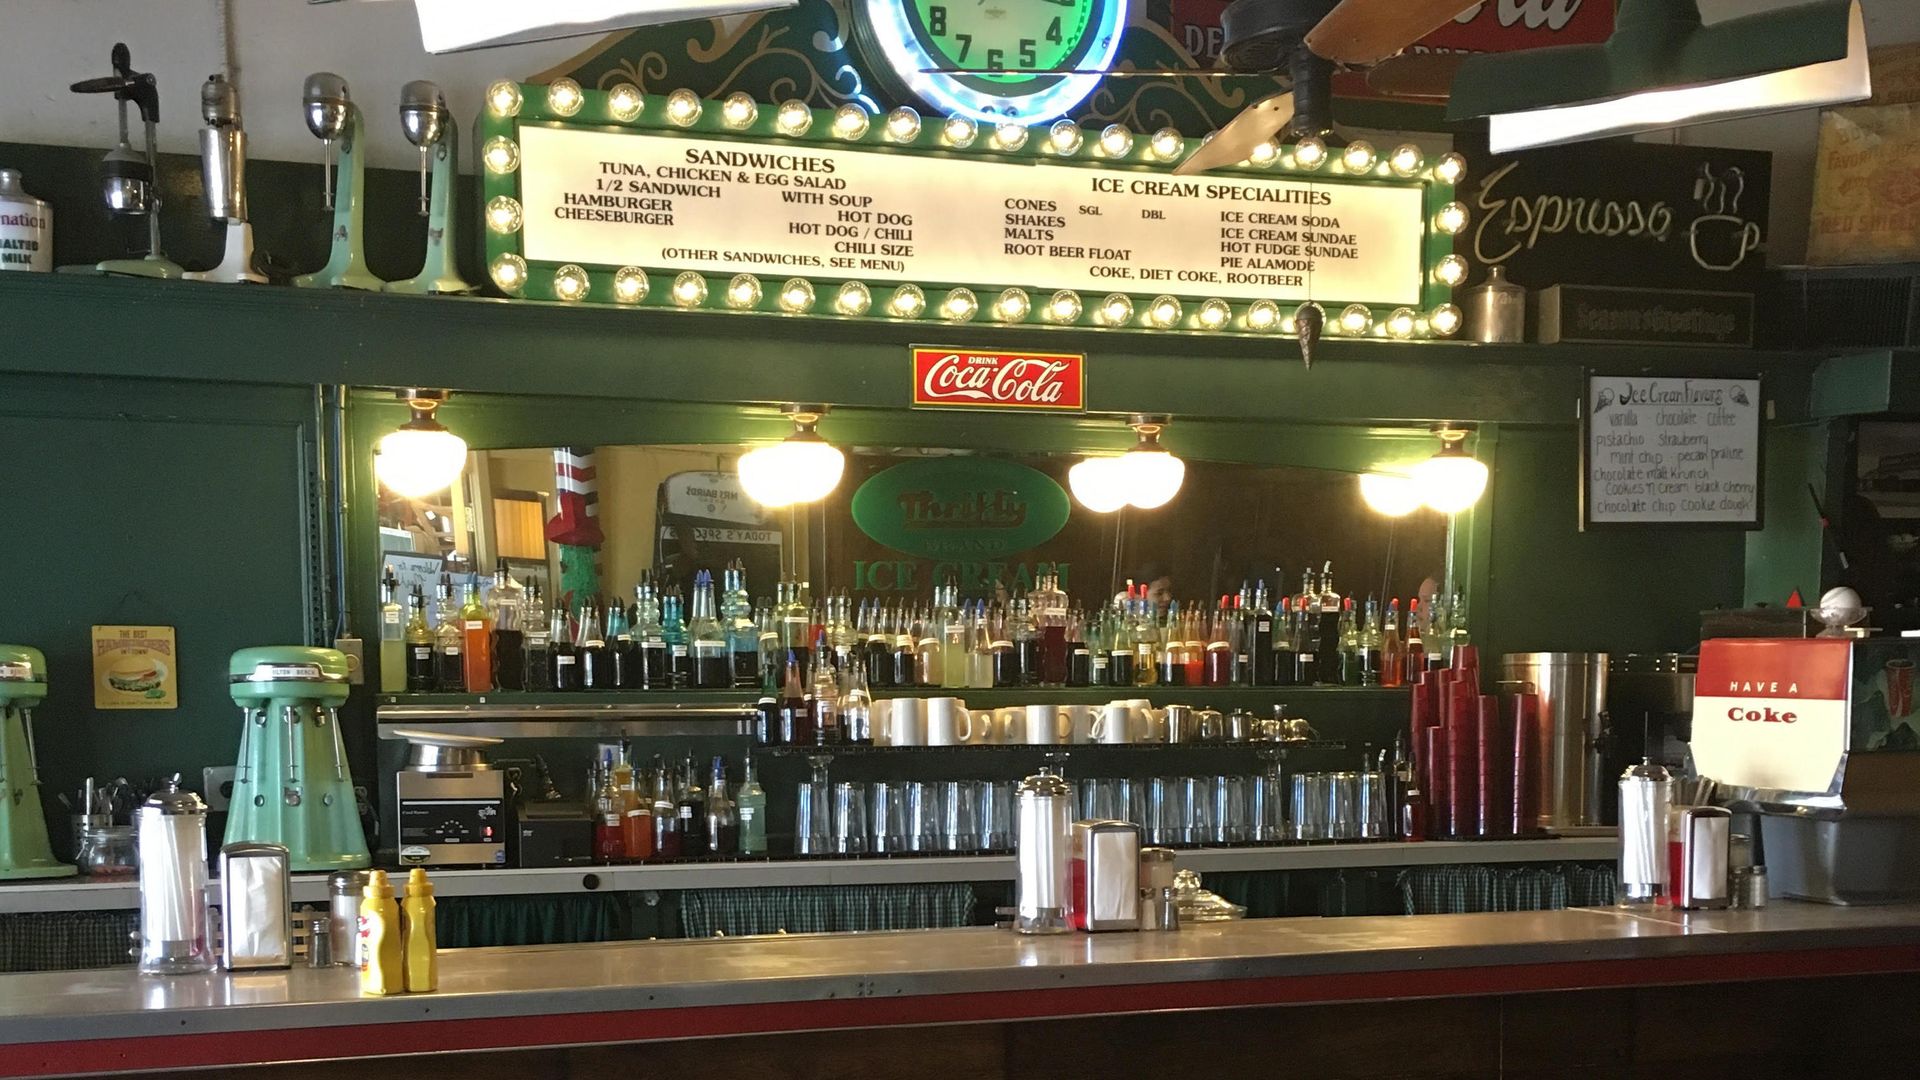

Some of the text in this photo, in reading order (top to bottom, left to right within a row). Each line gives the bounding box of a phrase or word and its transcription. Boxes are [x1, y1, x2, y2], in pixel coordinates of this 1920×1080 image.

[930, 6, 947, 37] 8
[1045, 16, 1062, 45] 4
[955, 34, 972, 63] 7
[1019, 39, 1036, 68] 5
[987, 49, 1003, 77] 6
[685, 148, 836, 173] SANDWICHES
[599, 161, 847, 190] TUNA, CHICKEN & EGG SALAD
[596, 178, 721, 199] 1/2 SANDWICH
[1091, 177, 1332, 206] ICE CREAM SPECIALITIES
[563, 192, 673, 212] HAMBURGER
[781, 190, 873, 208] WITH SOUP
[1004, 198, 1058, 213] CONES
[554, 207, 674, 226] CHEESEBURGER
[837, 210, 914, 226] HOT DOG
[1079, 204, 1103, 216] SGL
[1141, 208, 1167, 221] DBL
[1474, 160, 1674, 265] Espresso
[1004, 213, 1067, 229] SHAKES
[1220, 211, 1341, 229] ICE CREAM SODA
[788, 222, 913, 241] HOT DOG / CHILI
[1004, 227, 1055, 242] MALTS
[1220, 227, 1357, 246] ICE CREAM SUNDAE
[0, 238, 39, 252] ALTED
[834, 241, 914, 258] CHILI SIZE
[1004, 243, 1132, 262] ROOT BEER FLOAT
[1220, 241, 1359, 259] HOT FUDGE SUNDAE
[1, 252, 32, 265] MILK
[661, 247, 905, 273] (OTHER SANDWICHES, SEE MENU)
[1220, 256, 1315, 272] PIE ALAMODE
[1089, 265, 1303, 287] COKE, DIET COKE, ROOTBEER
[967, 355, 999, 366] DRINK
[923, 354, 1072, 403] Coca-Cola
[1609, 408, 1736, 427] vanilla chocolate coffee
[1596, 430, 1709, 456] pistachio strawberry
[1610, 447, 1744, 470] mint chip pecan praline
[1594, 466, 1643, 482] chocolate
[1646, 466, 1668, 480] malt
[1695, 480, 1720, 493] black
[1723, 480, 1755, 497] cherry
[896, 489, 1027, 530] Thrifty
[1597, 499, 1647, 514] chocolate
[1652, 499, 1676, 516] chip
[1719, 497, 1749, 516] dough
[852, 560, 1071, 592] ICE CREAM
[120, 629, 148, 638] THE BEST
[1729, 681, 1798, 694] HAVE A
[1727, 707, 1797, 724] Coke
